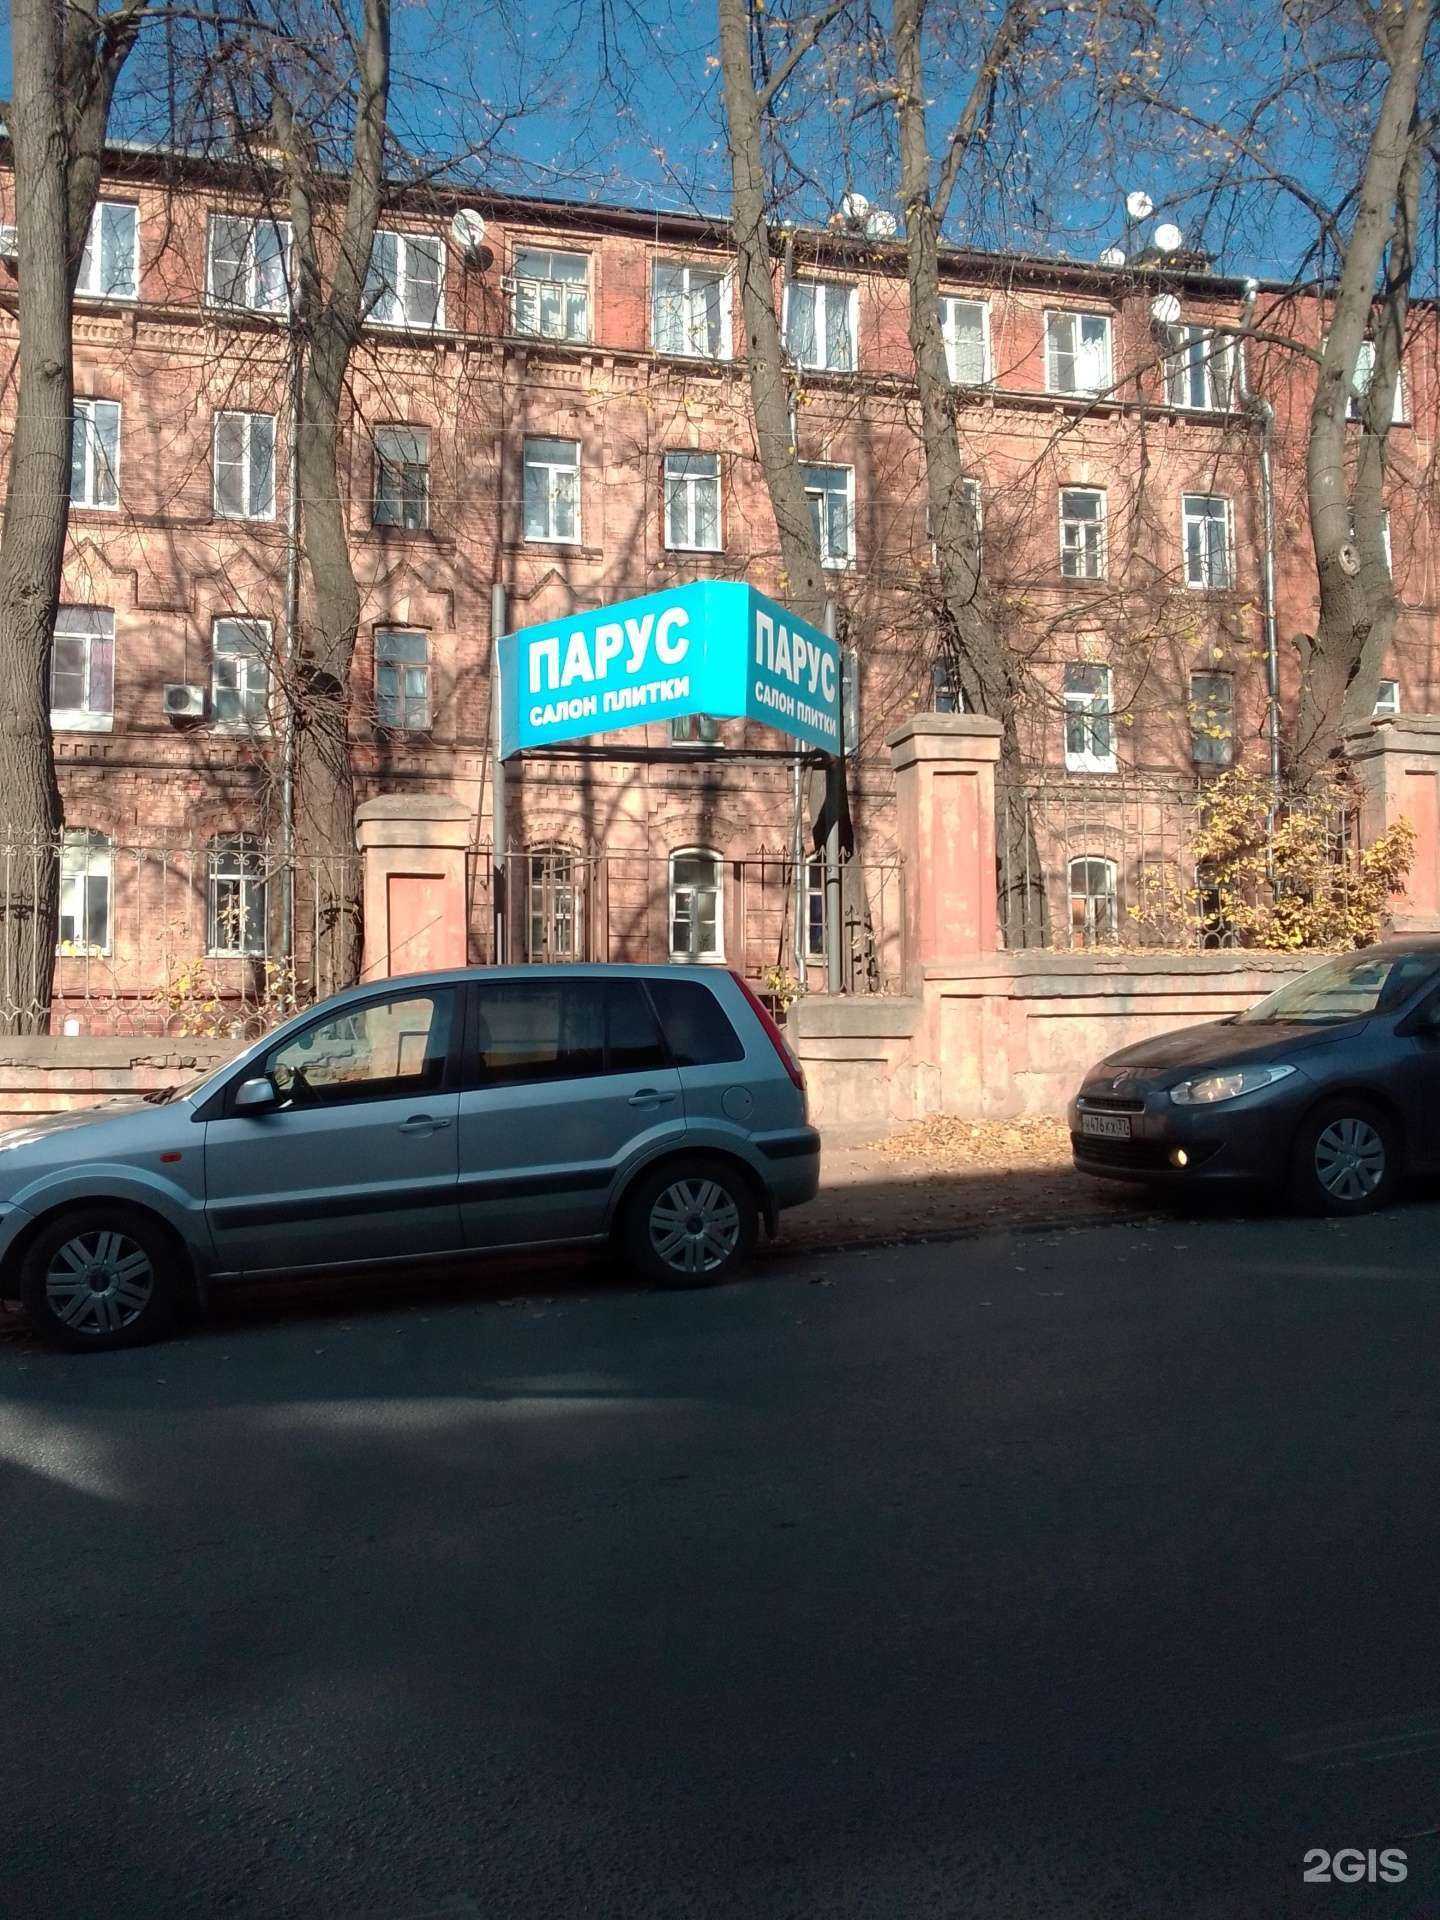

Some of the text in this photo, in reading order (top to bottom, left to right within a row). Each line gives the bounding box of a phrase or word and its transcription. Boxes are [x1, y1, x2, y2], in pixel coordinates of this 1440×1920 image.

[529, 607, 690, 693] ПАРУС
[755, 610, 836, 702] ПАРУС
[529, 676, 690, 726] САЛОН ПЛИТКИ
[755, 681, 837, 736] САЛОН ПЛИТКИ
